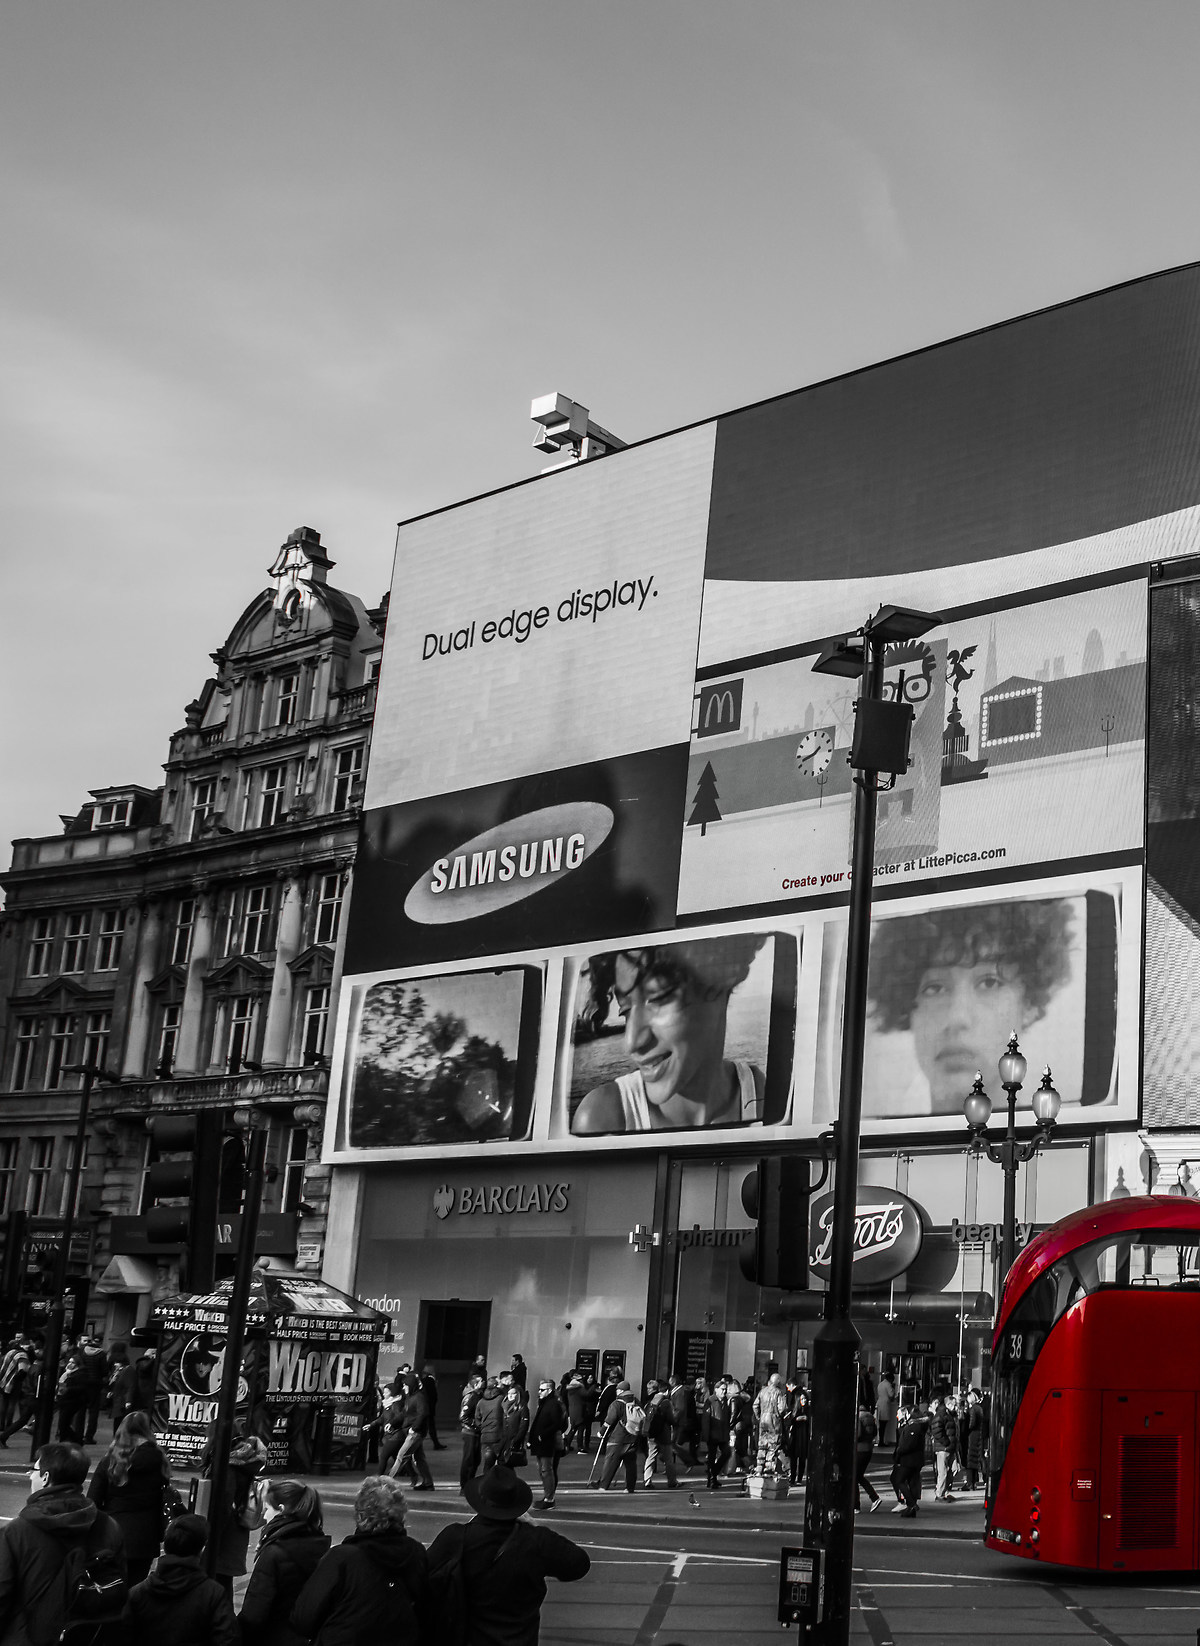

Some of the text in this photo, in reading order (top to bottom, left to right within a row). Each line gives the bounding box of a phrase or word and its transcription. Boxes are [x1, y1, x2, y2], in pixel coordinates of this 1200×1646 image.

[422, 575, 659, 661] Dual edge display.
[430, 833, 586, 894] SAMSUNG
[781, 847, 1007, 890] Create your cacter at LittePicca.com
[457, 1183, 571, 1214] BARCLAYS
[680, 1224, 744, 1251] pharm
[195, 1309, 226, 1323] WICKED
[164, 1321, 184, 1331] HALF
[184, 1323, 206, 1332] PRICE
[310, 1320, 315, 1329] IS
[316, 1320, 325, 1329] THE
[326, 1320, 339, 1330] BEST
[339, 1321, 353, 1331] SHOW
[353, 1322, 359, 1331] IN
[276, 1330, 292, 1338] HALF
[292, 1331, 308, 1339] PRICE
[343, 1333, 358, 1341] BOOK
[359, 1334, 372, 1342] HERE
[391, 1343, 405, 1353] Blue
[1009, 1334, 1023, 1358] 38
[265, 1340, 368, 1393] WICKED
[266, 1394, 276, 1402] THE
[168, 1393, 220, 1423] WICK
[333, 1413, 359, 1426] ENSATION
[171, 1433, 179, 1441] THE
[192, 1435, 209, 1443] POPULA
[267, 1441, 289, 1449] APOLLO
[266, 1450, 289, 1458] ICTORIA
[266, 1459, 288, 1467] HEATRE
